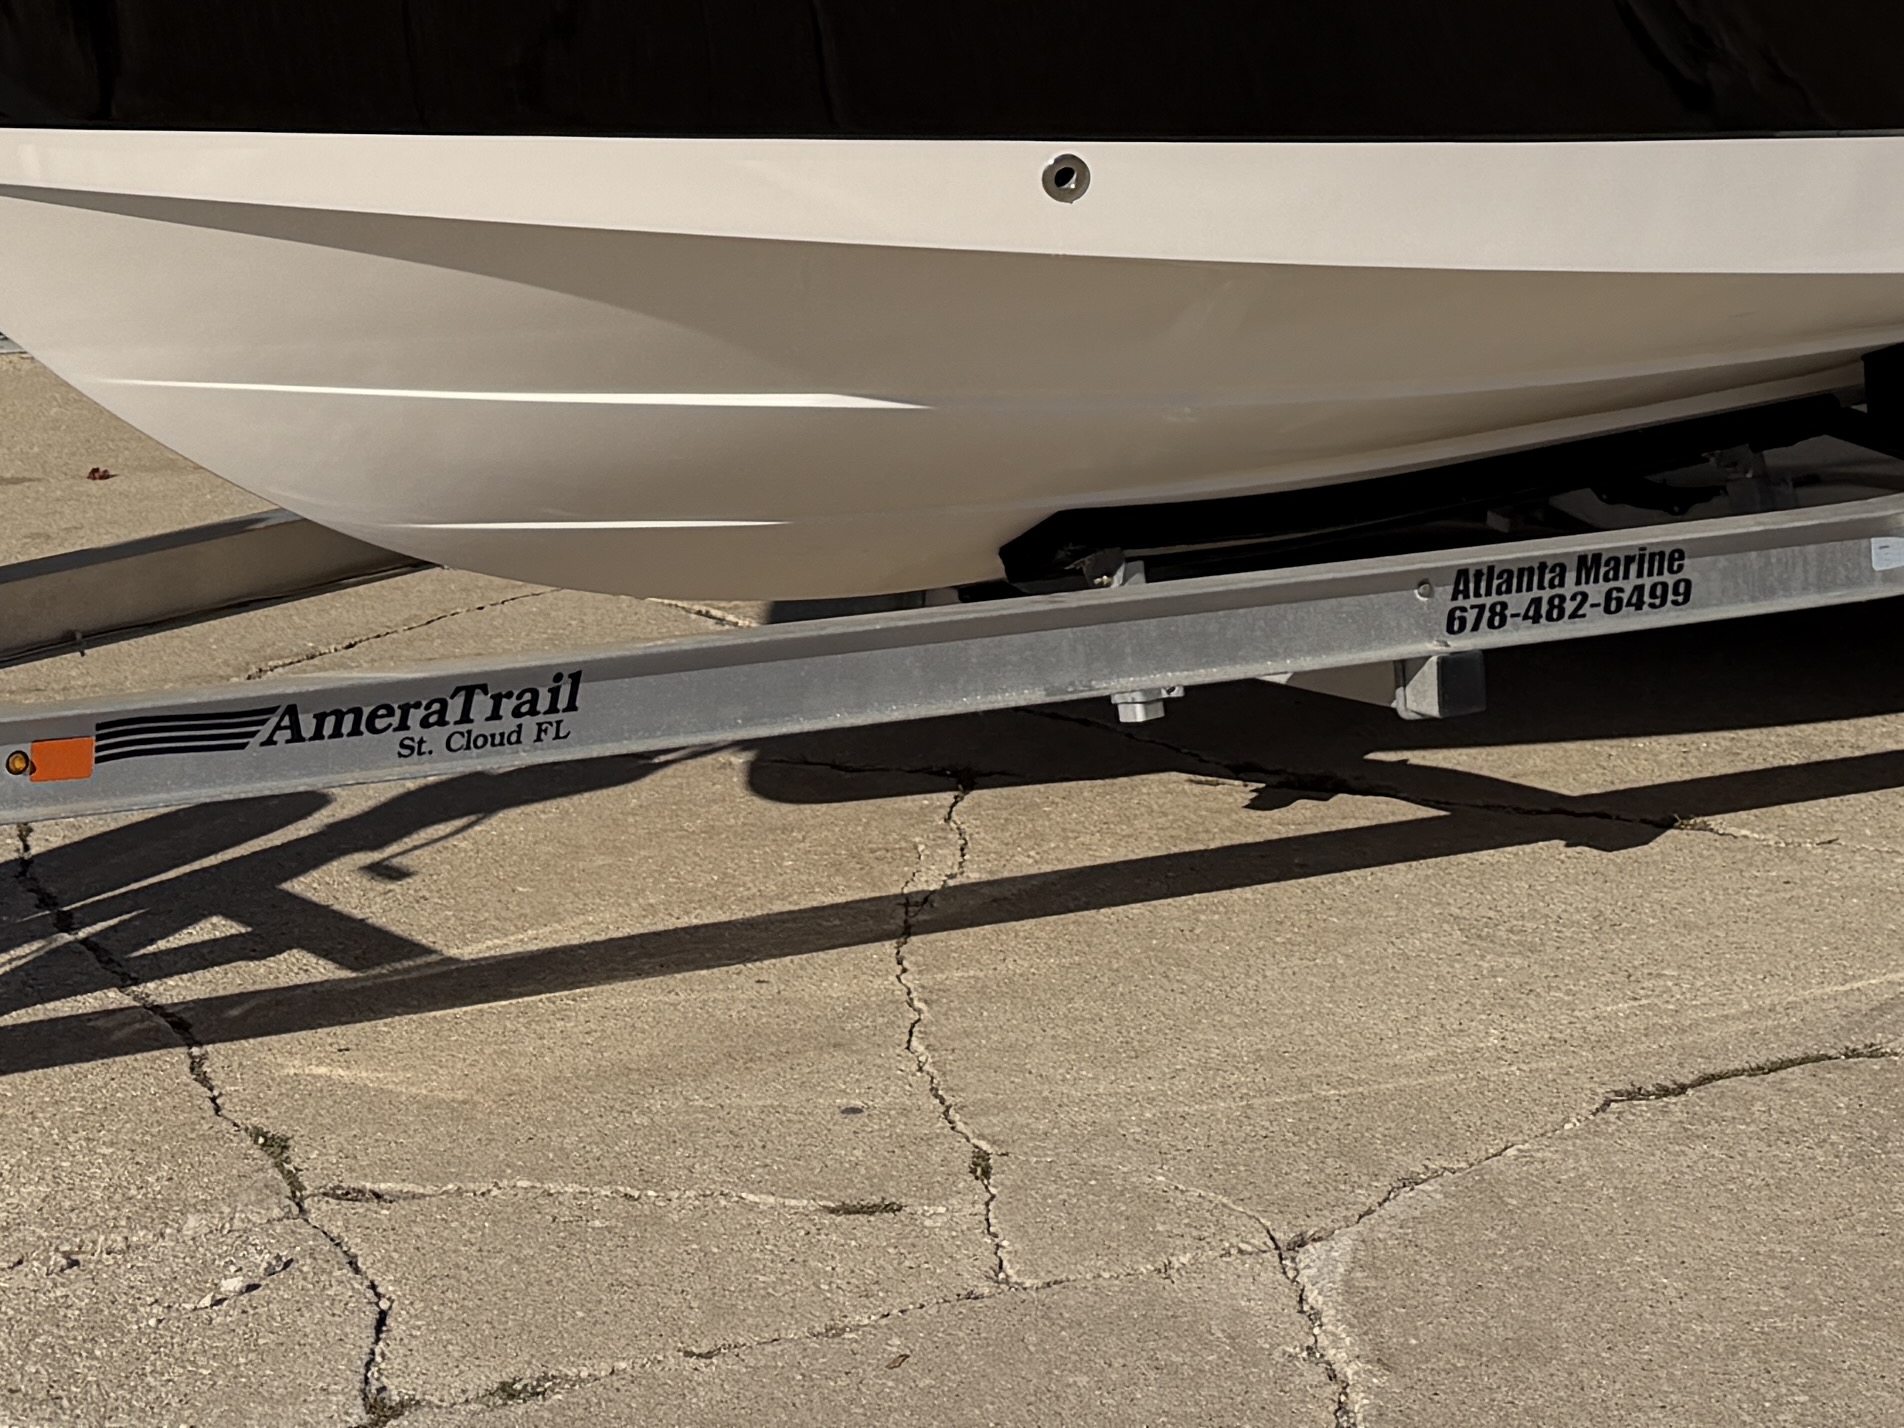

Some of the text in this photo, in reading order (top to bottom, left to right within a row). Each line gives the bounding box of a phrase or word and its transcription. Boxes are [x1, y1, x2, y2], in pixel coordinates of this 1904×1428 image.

[1450, 546, 1685, 602] Atlanta Marine
[1445, 577, 1693, 636] 678-482-6499
[259, 669, 584, 747] AmeraTrail
[396, 720, 572, 760] St. Cloud FL
